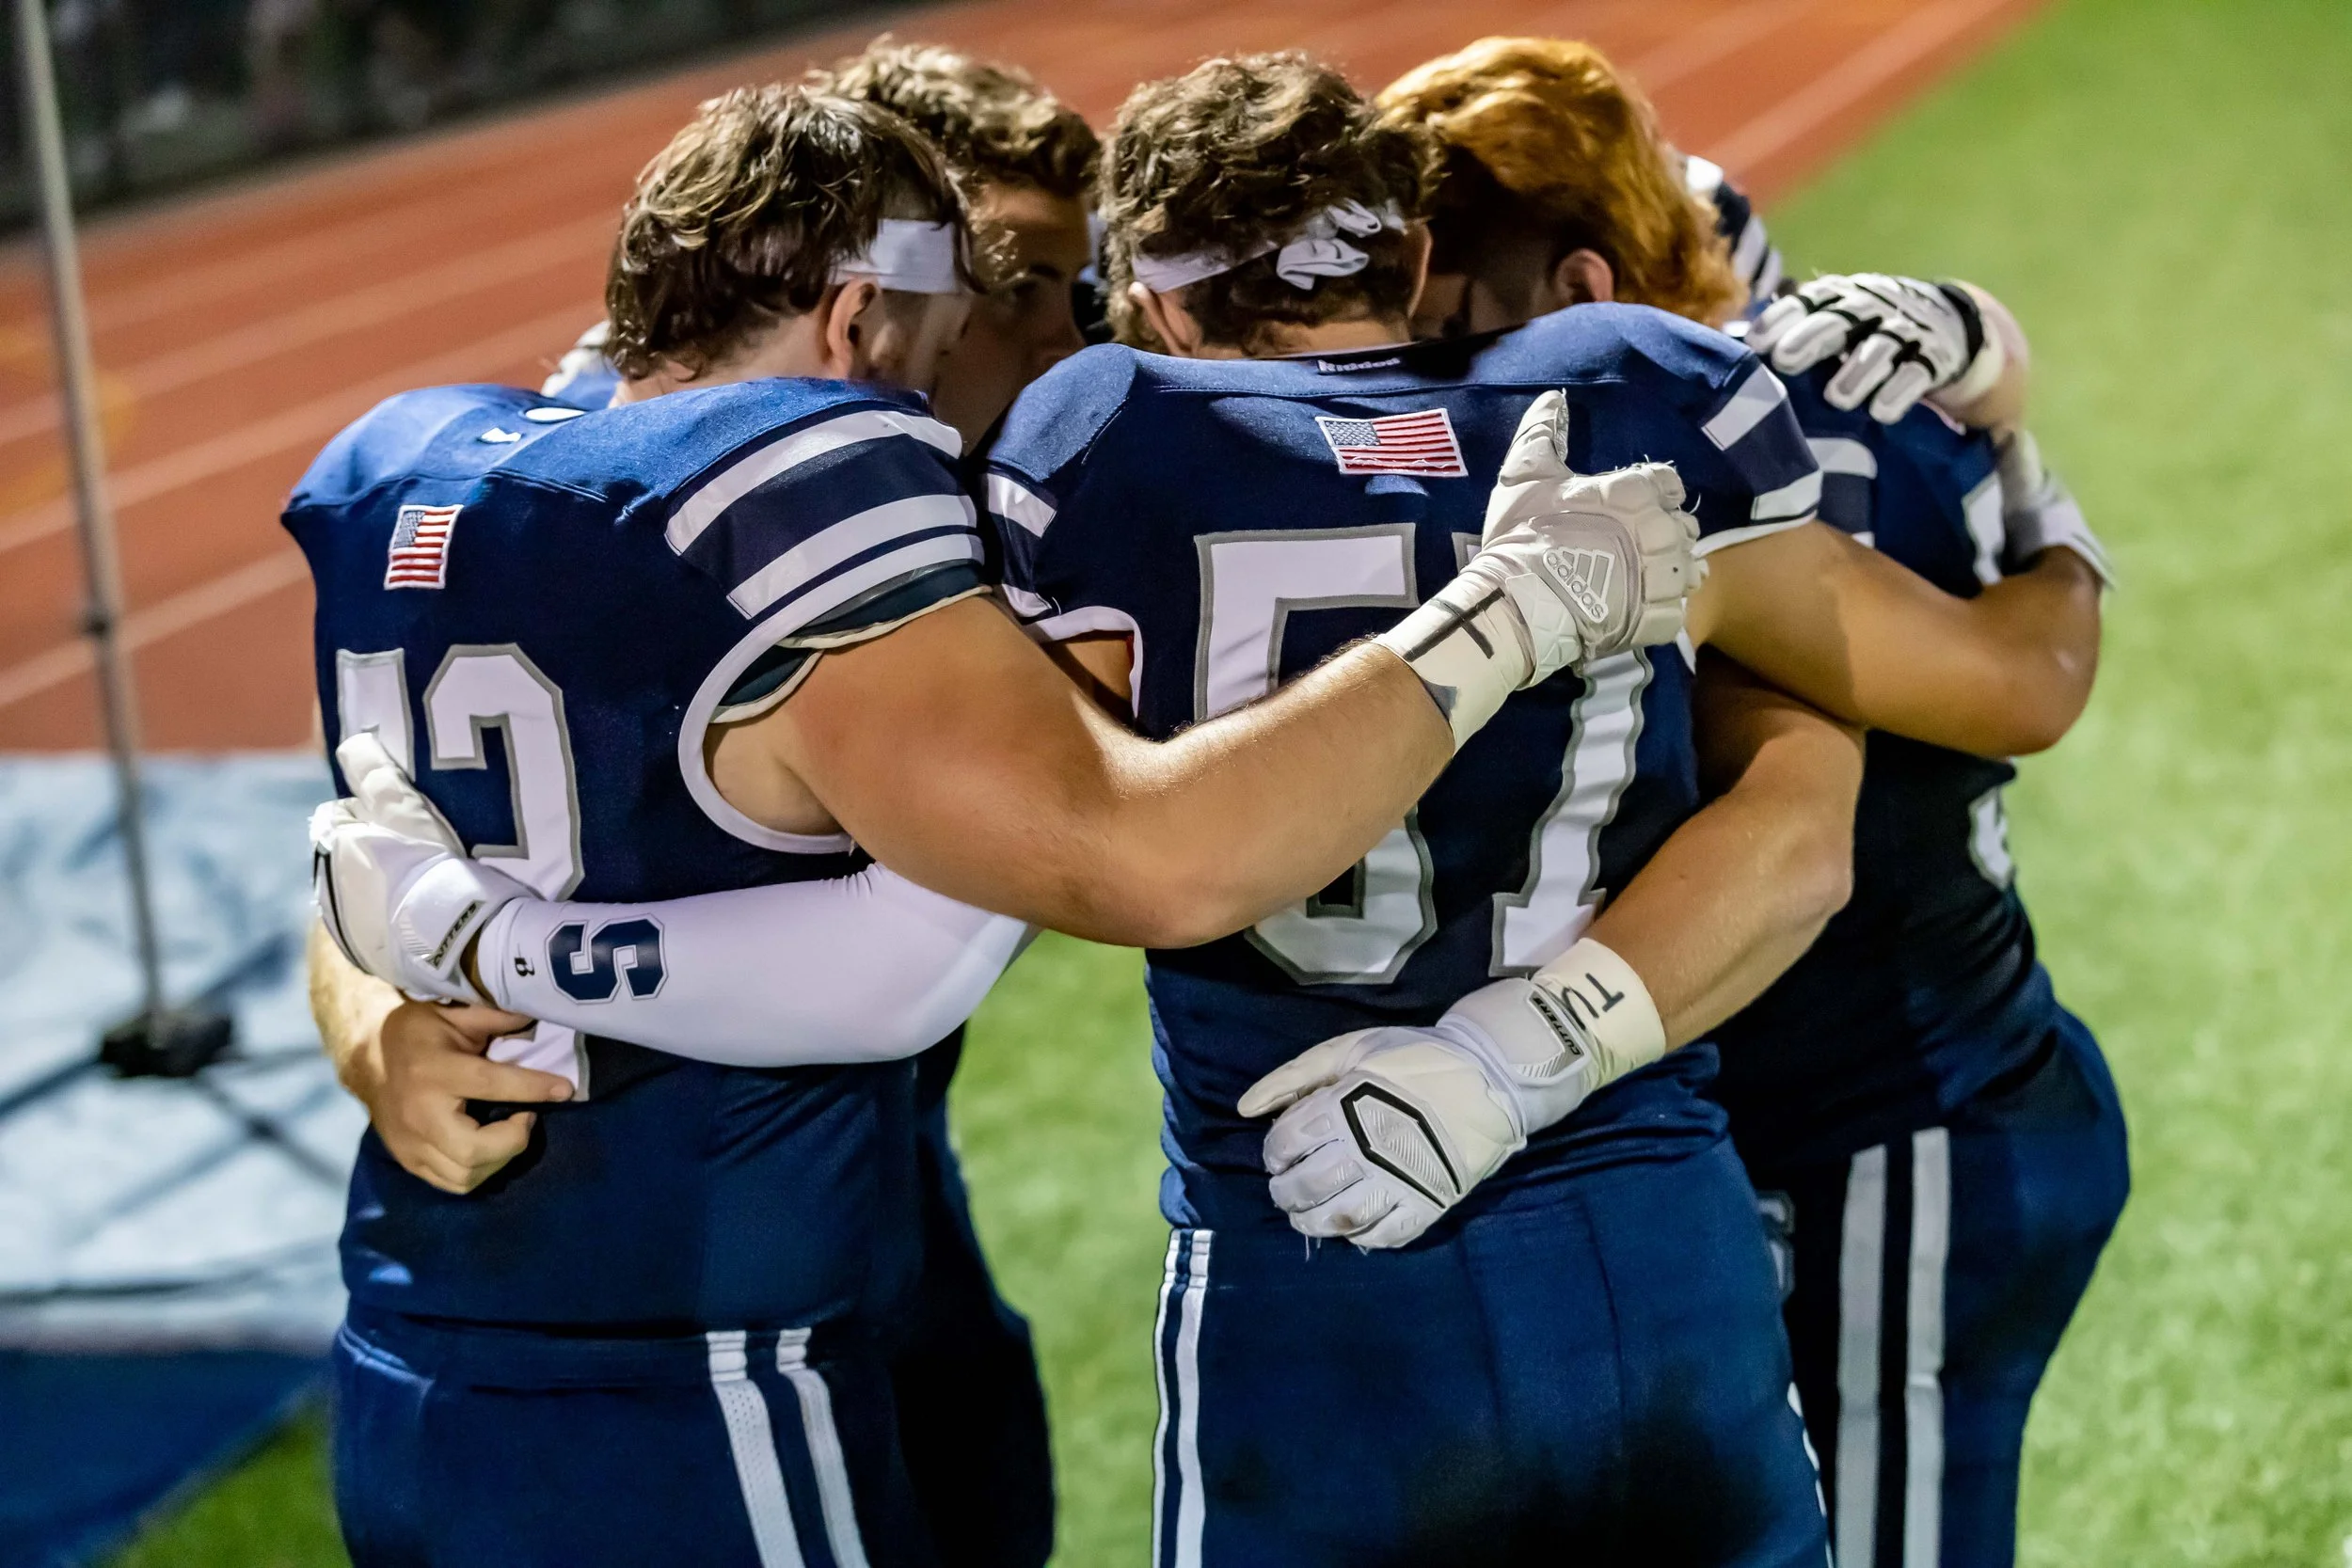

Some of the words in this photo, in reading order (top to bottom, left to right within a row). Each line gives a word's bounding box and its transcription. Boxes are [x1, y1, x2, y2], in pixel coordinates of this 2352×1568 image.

[1546, 551, 1605, 619] adidas
[429, 902, 478, 968] CUTTERS
[1533, 997, 1582, 1055] CUTTERS
